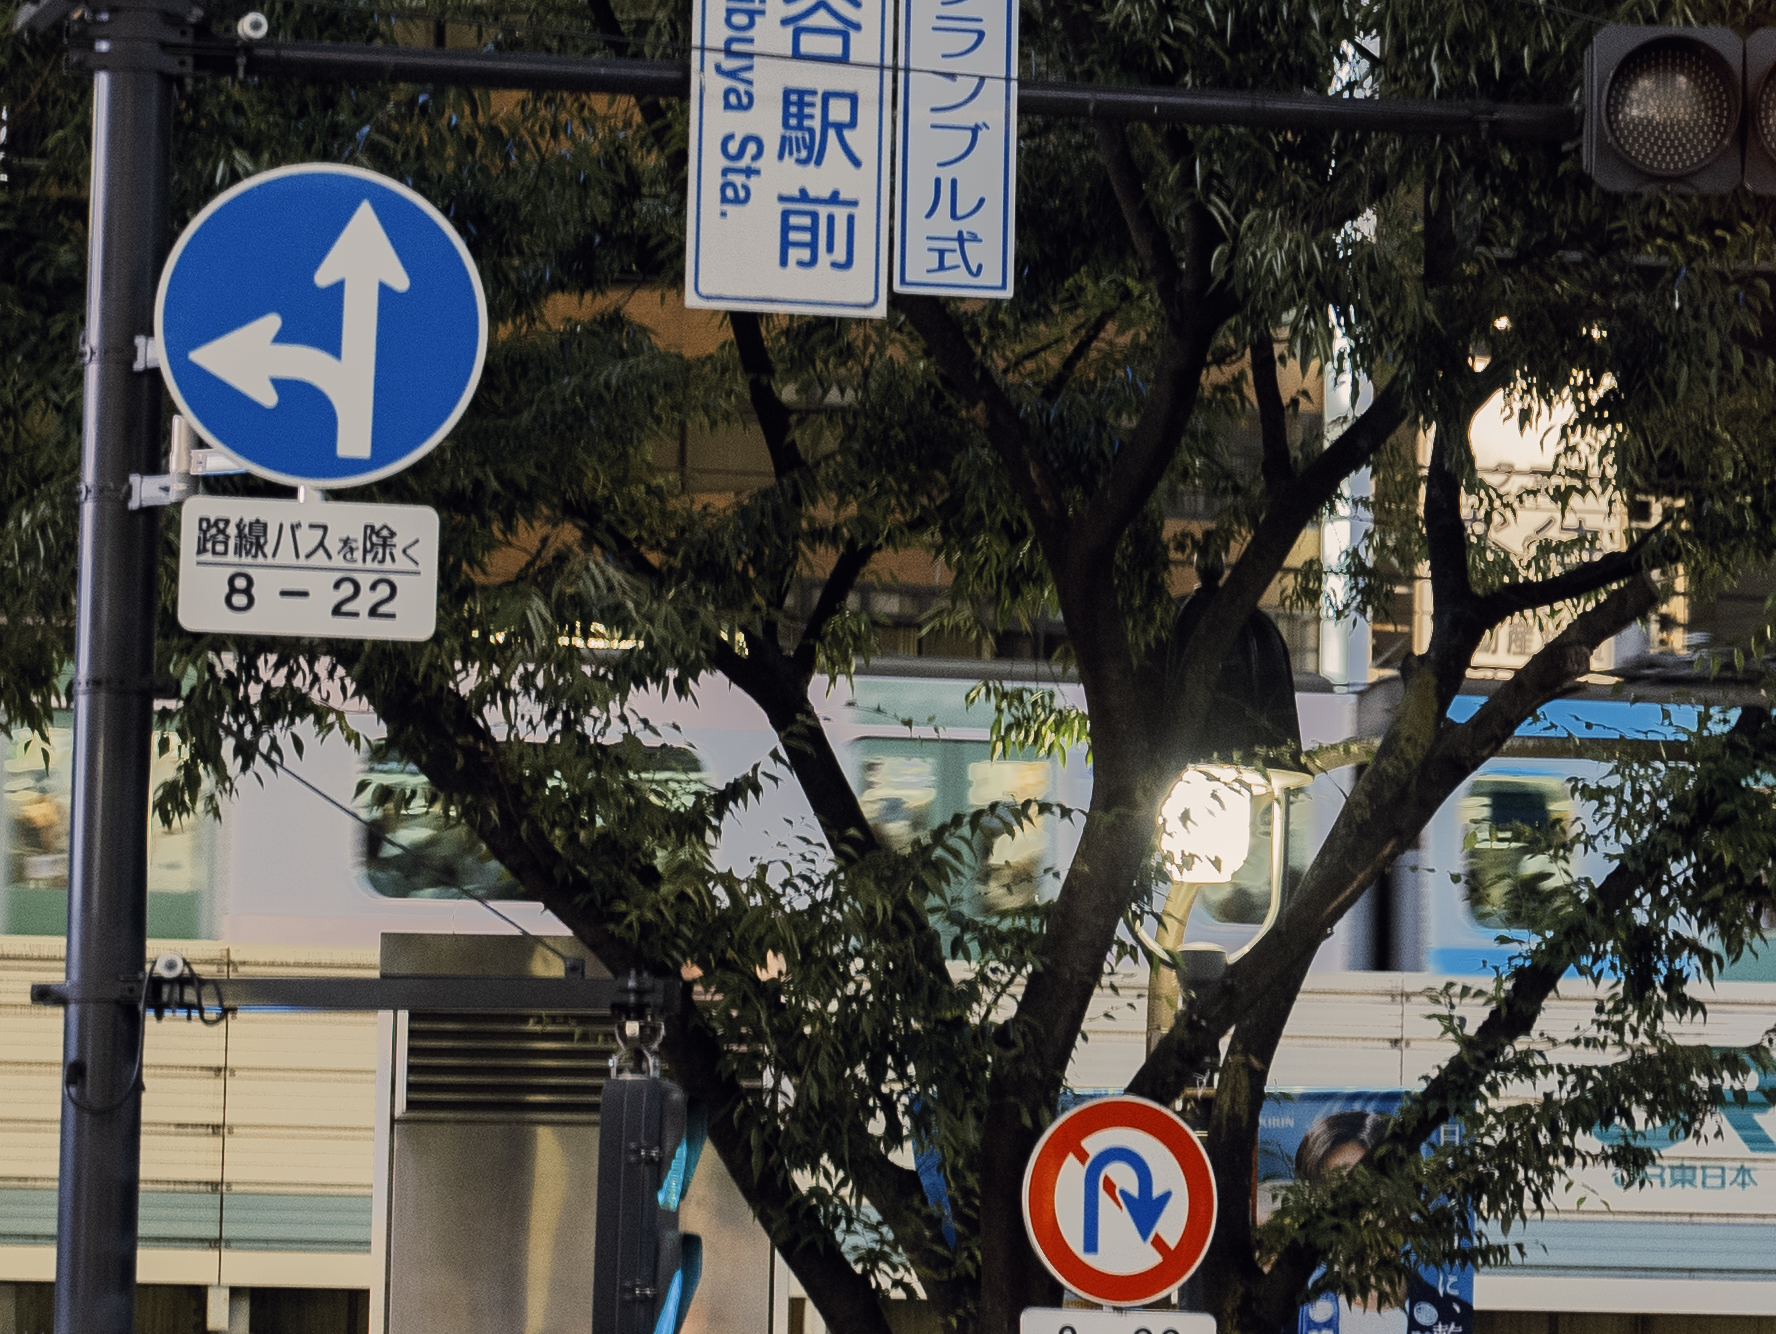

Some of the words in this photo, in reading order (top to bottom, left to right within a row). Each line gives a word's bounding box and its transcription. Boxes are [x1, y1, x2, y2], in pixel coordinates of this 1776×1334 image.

[719, 133, 764, 220] Sta.
[196, 515, 420, 566] 路線バスを除く
